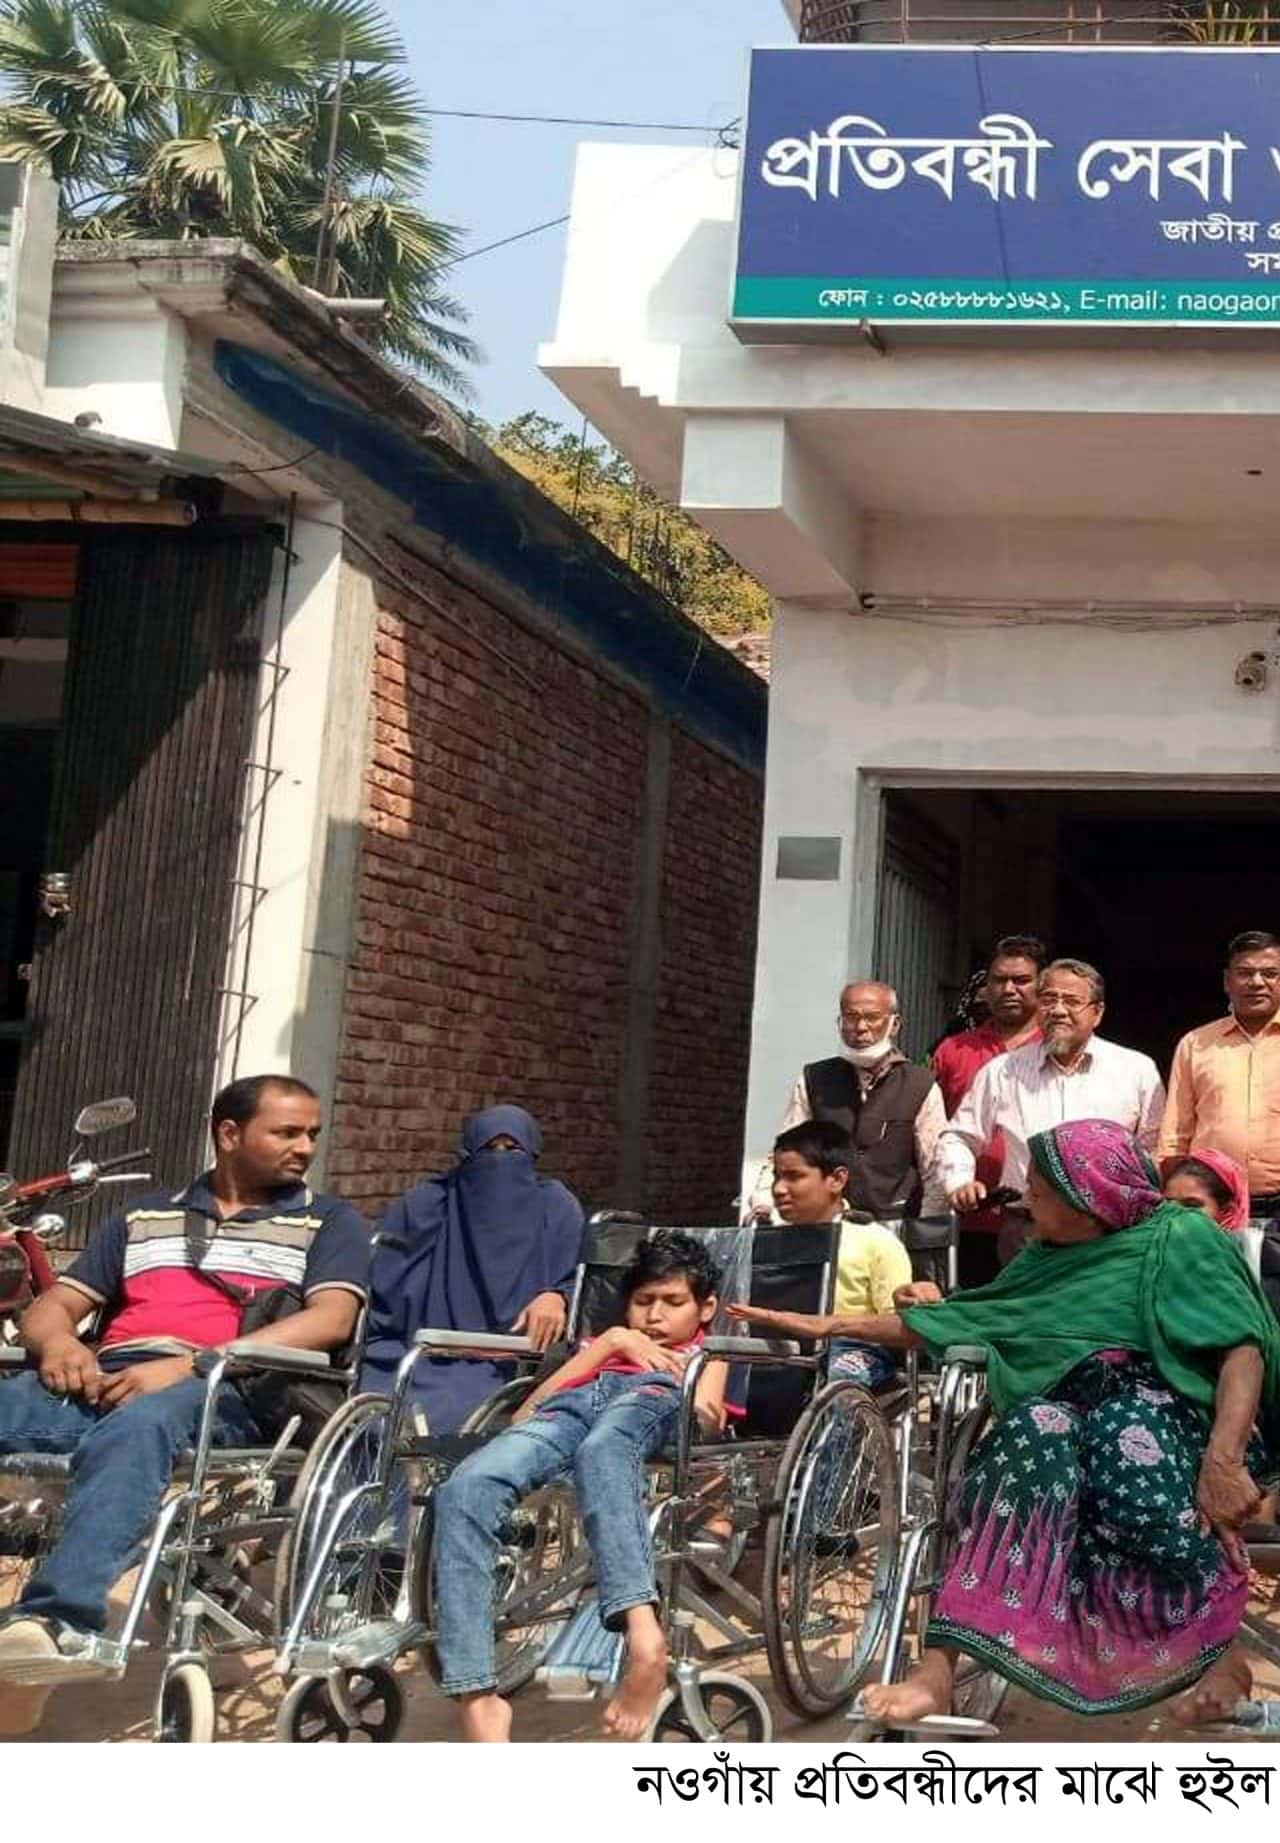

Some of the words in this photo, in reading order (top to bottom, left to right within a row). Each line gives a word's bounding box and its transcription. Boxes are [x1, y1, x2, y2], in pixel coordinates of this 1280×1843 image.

[761, 113, 1053, 201] প্রতিবন্ধী
[1077, 131, 1247, 202] সেবা
[1159, 212, 1261, 243] জাতীয়
[819, 288, 868, 308] ফোন
[1081, 288, 1167, 310] E-mail:
